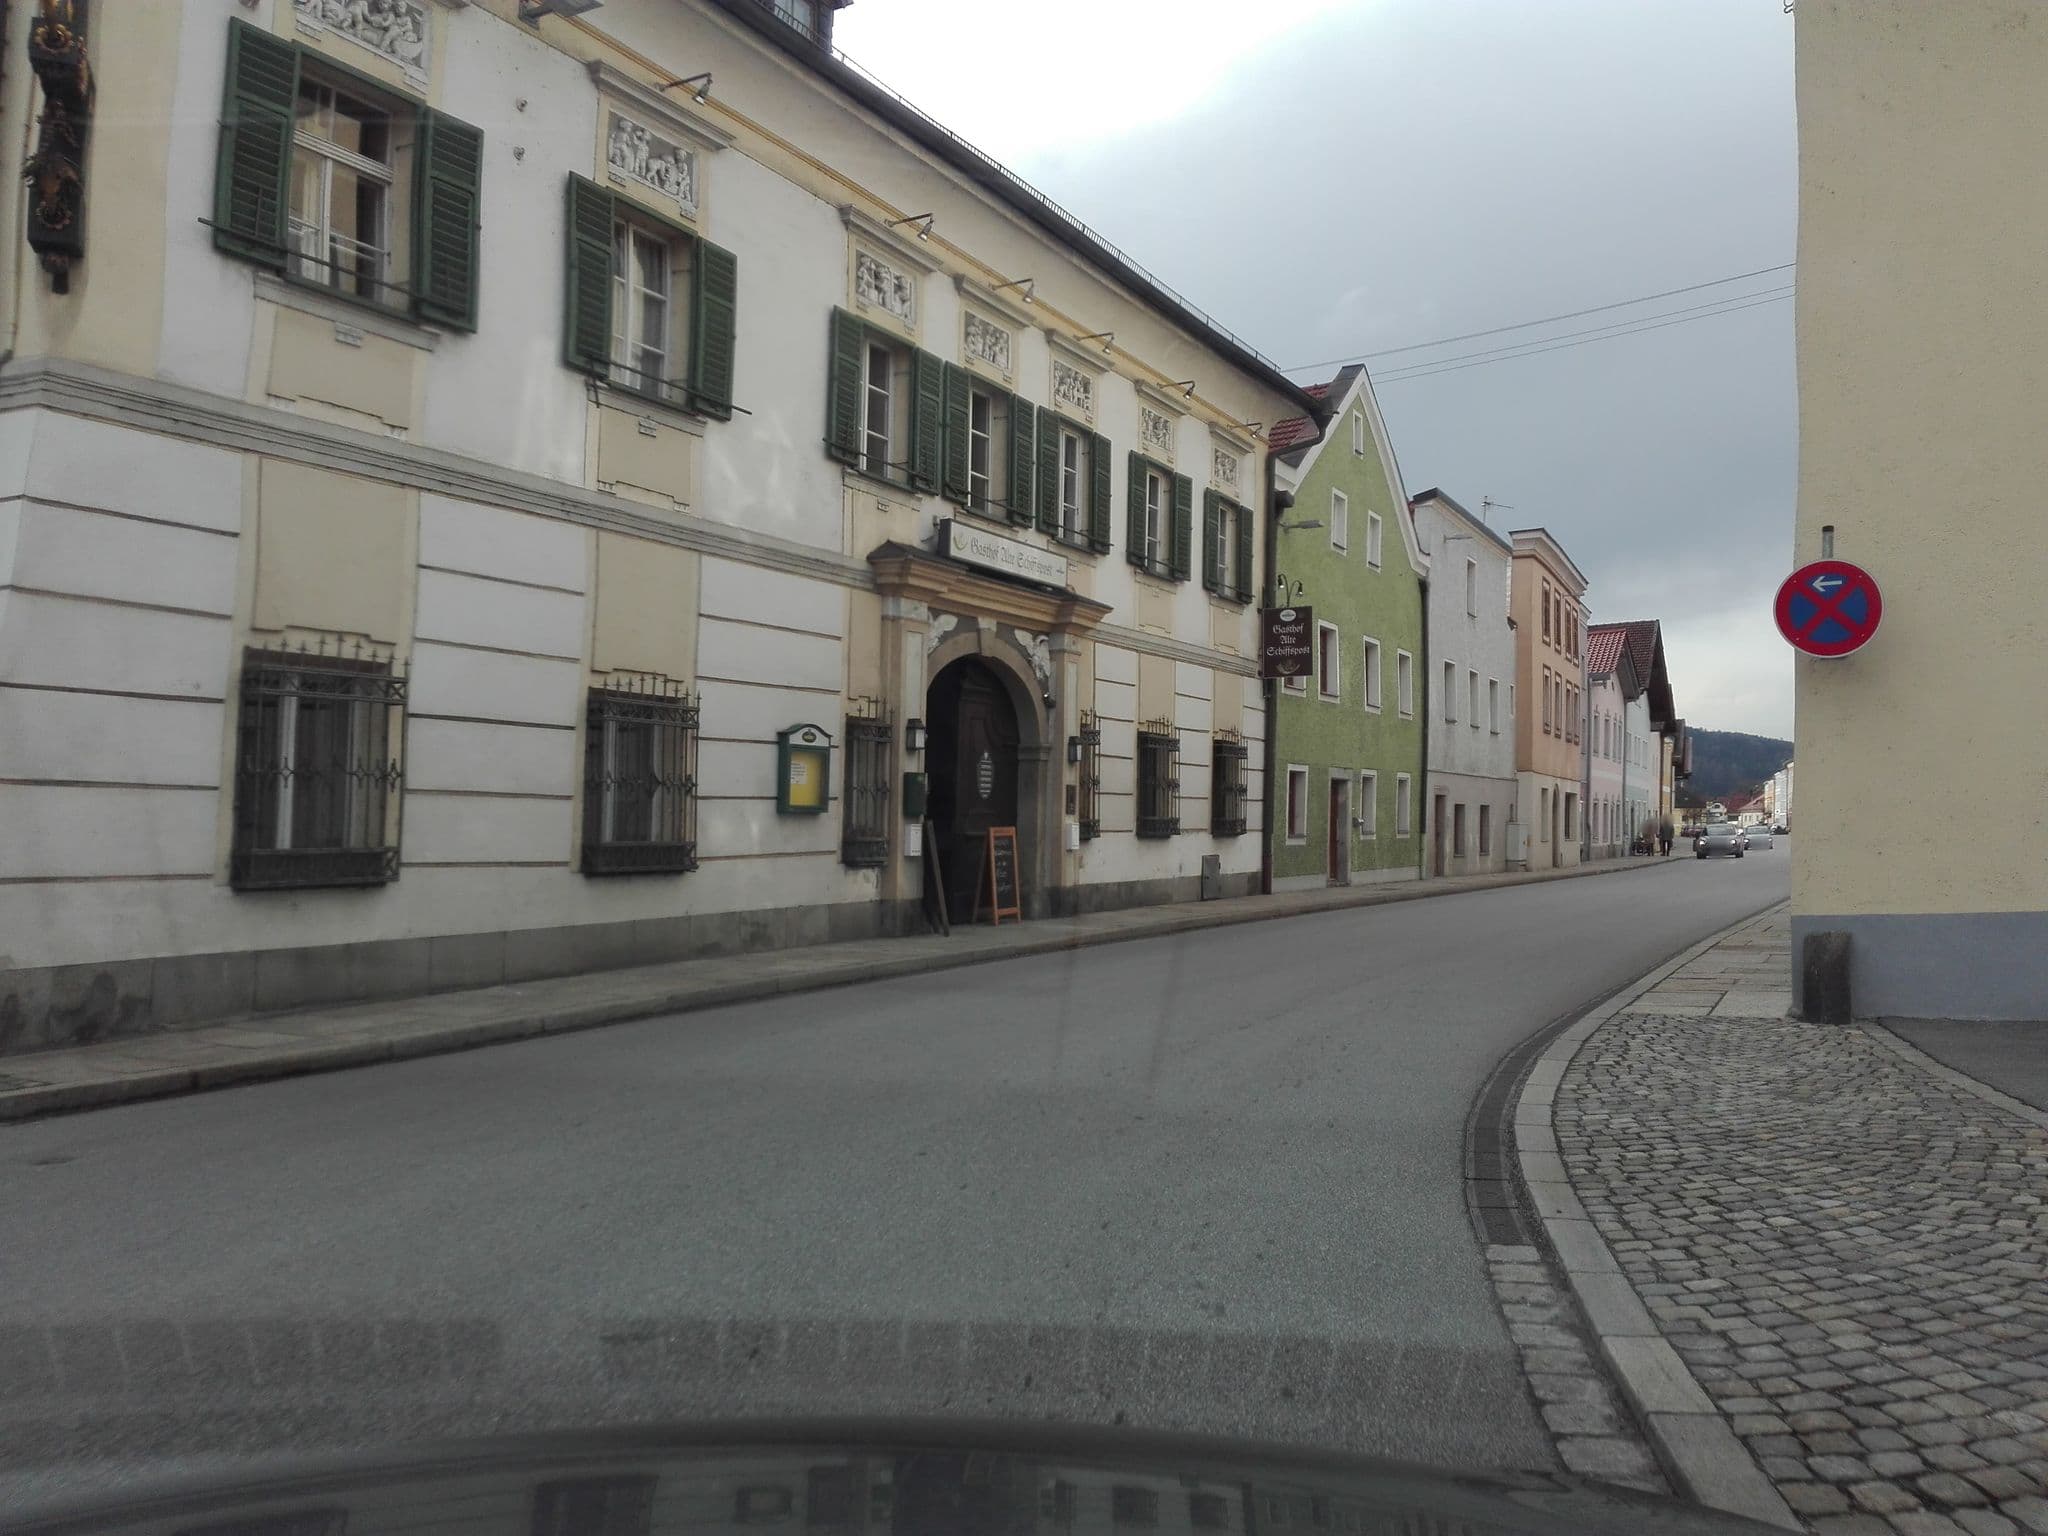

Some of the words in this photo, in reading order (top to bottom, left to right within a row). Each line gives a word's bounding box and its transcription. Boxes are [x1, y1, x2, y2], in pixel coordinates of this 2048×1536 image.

[970, 537, 1000, 560] Gasthof
[1272, 623, 1304, 634] Gasthof
[1279, 635, 1297, 644] Alte
[1266, 646, 1309, 656] Schiffspost
